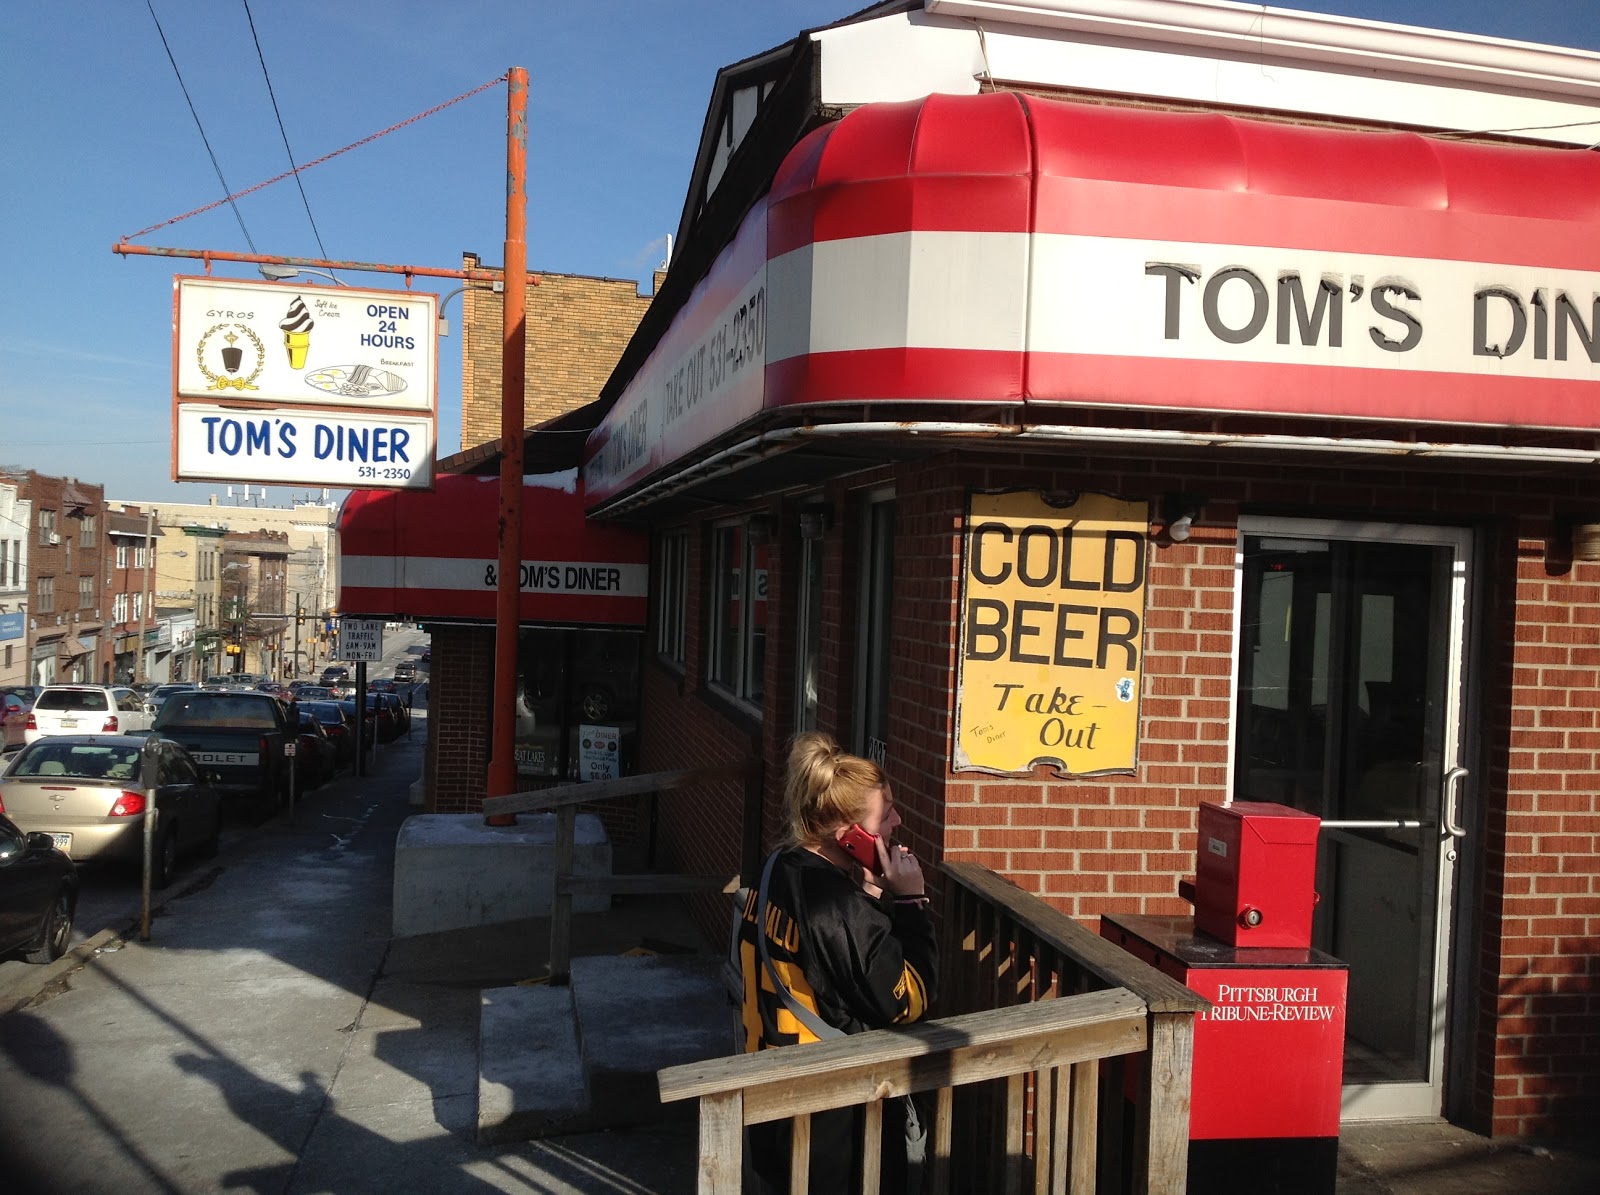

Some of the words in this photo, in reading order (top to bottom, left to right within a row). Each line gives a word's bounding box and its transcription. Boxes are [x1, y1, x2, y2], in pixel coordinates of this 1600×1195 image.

[315, 299, 328, 309] Soft
[206, 309, 255, 320] GYROS
[318, 309, 341, 318] Cream
[366, 304, 409, 320] OPEN
[1145, 261, 1423, 353] TOM'S
[1472, 281, 1600, 364] DIN
[378, 320, 398, 334] 24
[360, 333, 415, 350] HOURS
[666, 368, 684, 425] TAKE
[686, 344, 706, 409] OUT
[709, 285, 765, 393] 531-2350
[201, 417, 297, 459] TOM'S
[314, 424, 410, 463] DINER
[358, 466, 411, 480] 531-2350
[970, 521, 1145, 593] COLD
[484, 564, 498, 587] &
[519, 564, 560, 589] OM'S
[564, 566, 621, 591] DINER
[344, 622, 358, 631] TWO
[361, 622, 379, 631] LANE
[348, 632, 375, 641] TRAFFIC
[965, 597, 1140, 671] BEER
[345, 641, 377, 650] 6AM-9AM
[346, 651, 376, 660] MON-FRI
[595, 731, 617, 740] DINER
[1040, 717, 1101, 750] Out
[191, 753, 247, 763] ROLET
[590, 761, 610, 773] Only
[1217, 984, 1318, 1003] PITTSBURGH
